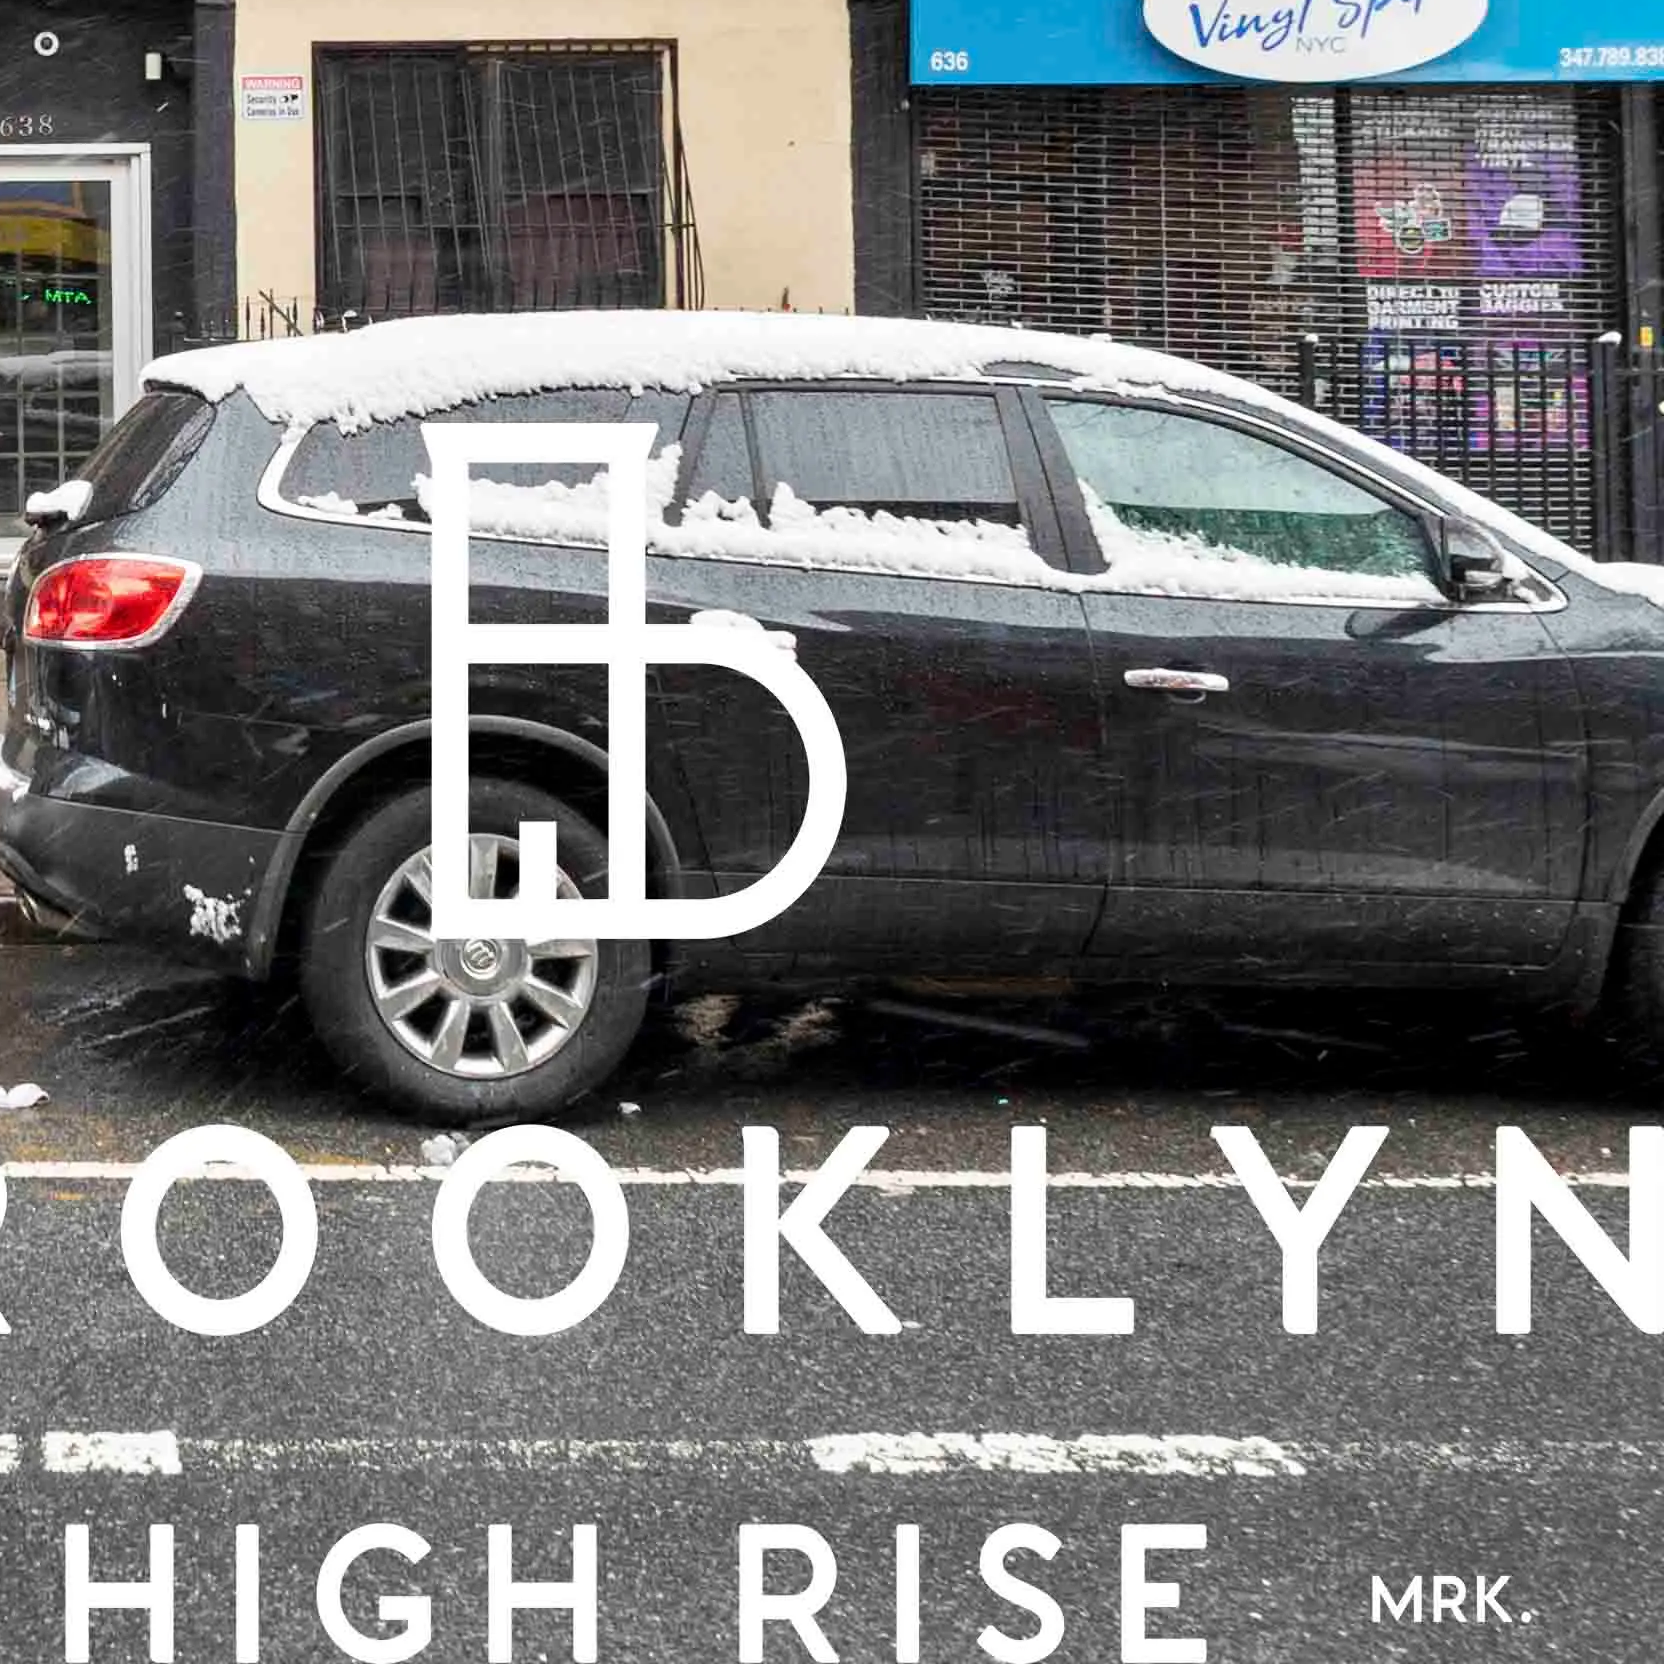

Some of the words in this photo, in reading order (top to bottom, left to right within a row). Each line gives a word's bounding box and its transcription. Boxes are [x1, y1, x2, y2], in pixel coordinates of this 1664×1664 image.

[1296, 36, 1347, 54] NYC
[930, 50, 969, 72] 636
[245, 78, 301, 90] WARNING
[0, 113, 54, 136] 638
[1366, 286, 1436, 299] DIRECT
[1480, 283, 1560, 298] CUSTOM
[1366, 300, 1459, 315] GARMENT
[1367, 315, 1459, 330] PRINTING
